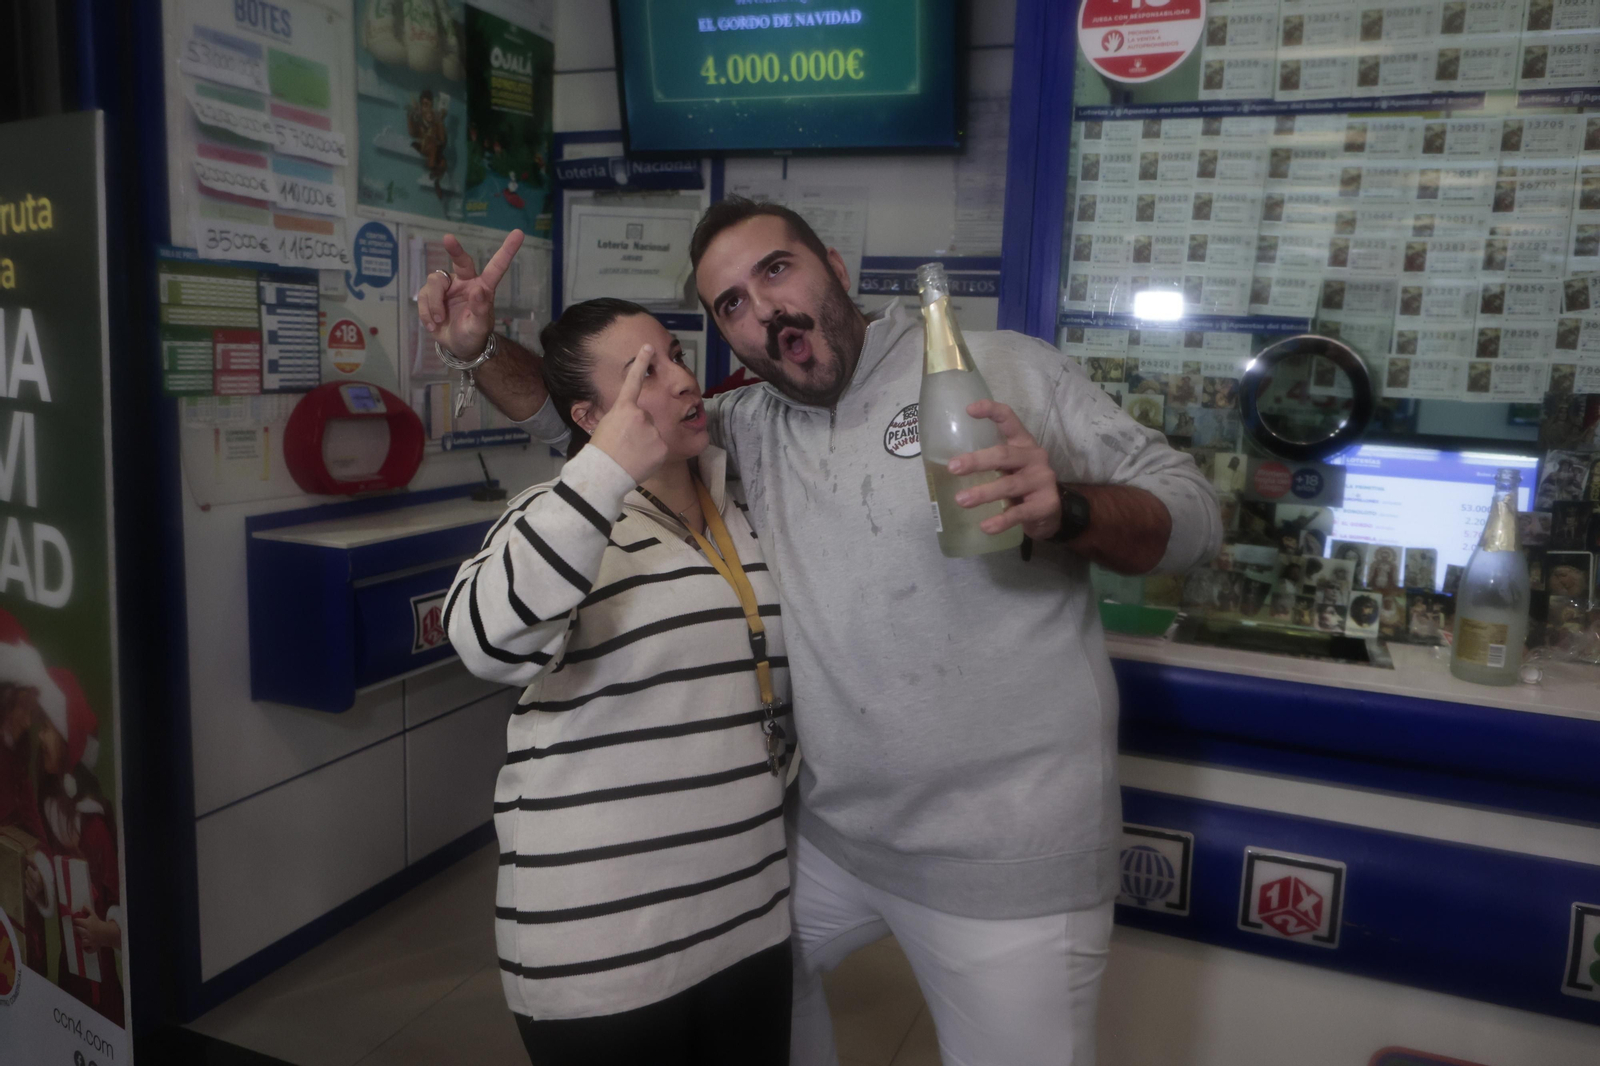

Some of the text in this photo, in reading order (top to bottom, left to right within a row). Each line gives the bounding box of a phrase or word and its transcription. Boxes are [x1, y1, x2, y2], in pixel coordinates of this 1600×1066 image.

[698, 9, 862, 32] EL GORDO DE NAVIDAD
[1092, 16, 1112, 24] JUEGA
[1129, 9, 1190, 20] RESPONSABILIDAD
[1551, 44, 1589, 55] 16551
[700, 48, 864, 85] 4.000.000€
[1173, 106, 1199, 114] Estado
[1432, 97, 1446, 106] del
[1528, 120, 1564, 131] 13705
[1521, 167, 1557, 177] 13705
[0, 193, 53, 235] ruta
[633, 241, 671, 252] Nacional
[862, 278, 878, 289] OS
[905, 279, 919, 290] LO
[950, 279, 996, 292] RTEOS
[334, 324, 358, 343] +18
[1296, 474, 1319, 487] +18
[53, 1008, 114, 1061] ccn4.com
